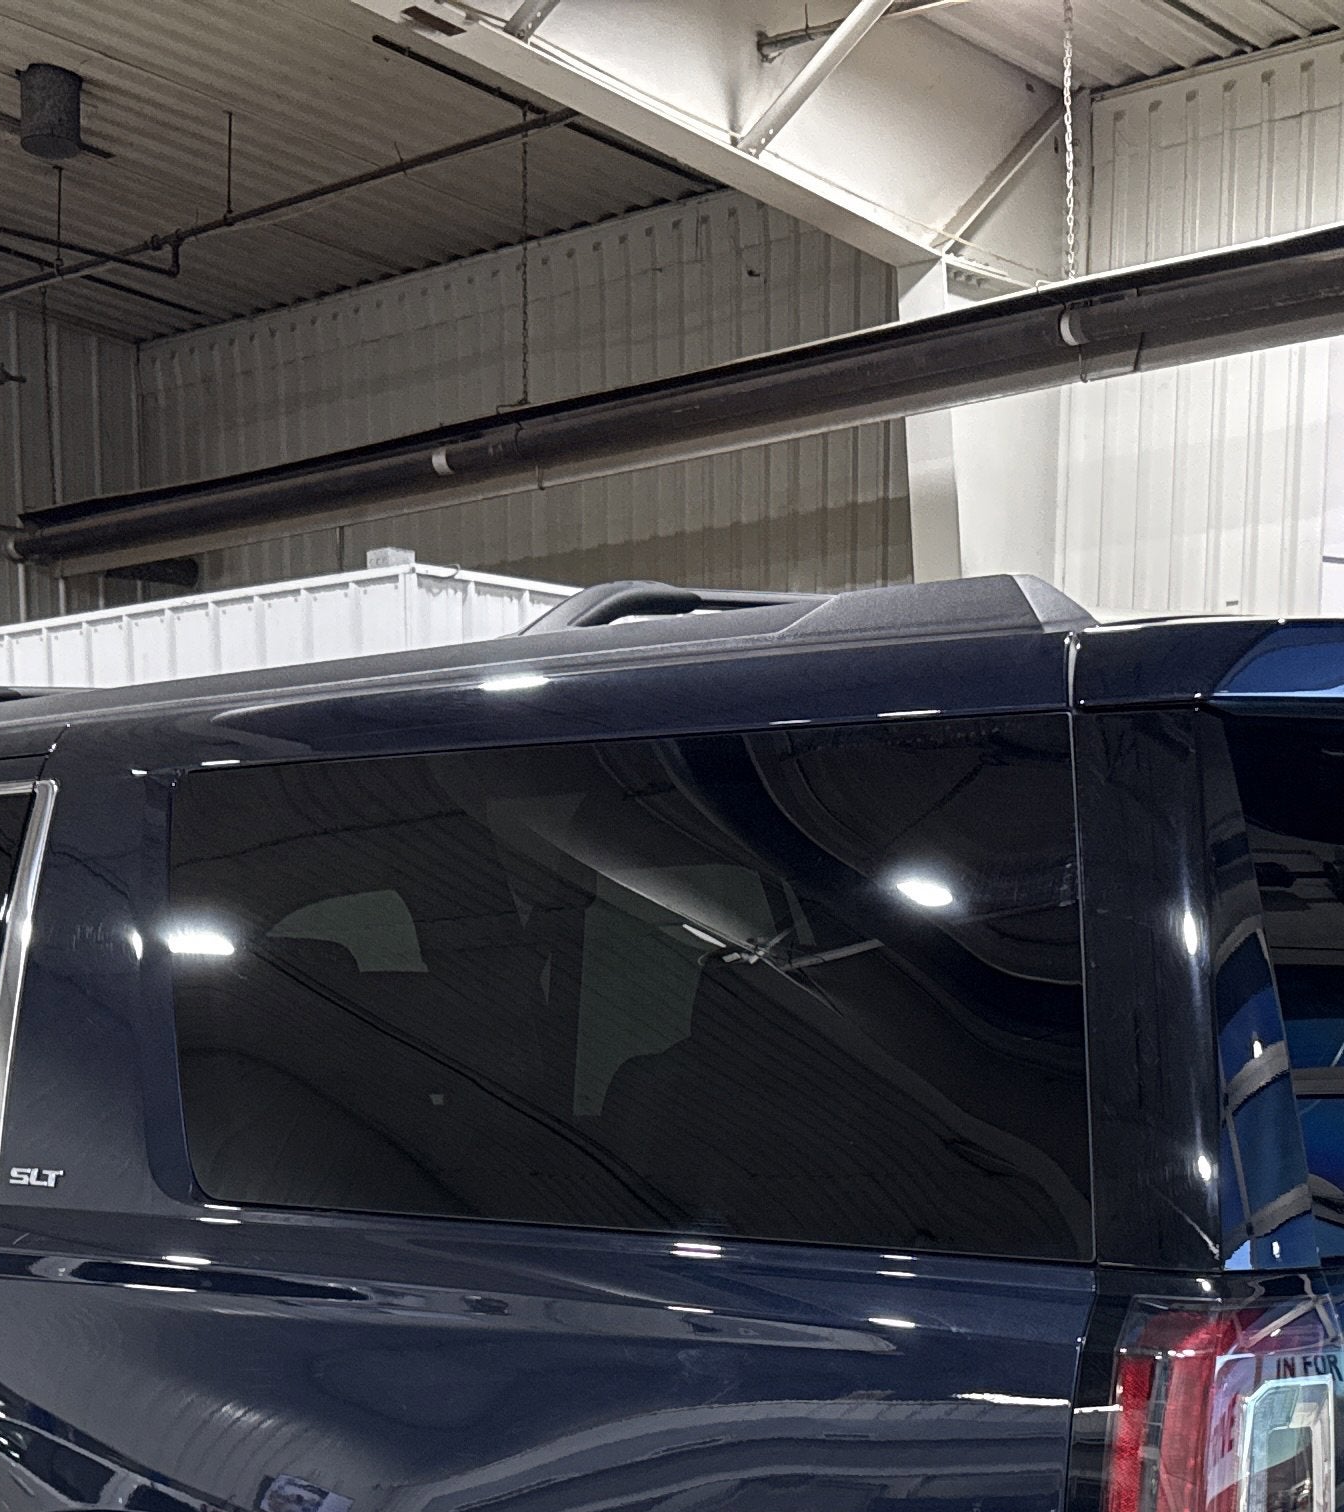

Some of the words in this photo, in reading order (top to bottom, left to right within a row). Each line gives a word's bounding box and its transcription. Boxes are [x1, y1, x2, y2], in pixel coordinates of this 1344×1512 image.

[9, 1167, 64, 1188] SLT
[1276, 1355, 1296, 1379] IN
[1302, 1354, 1344, 1381] FOR
